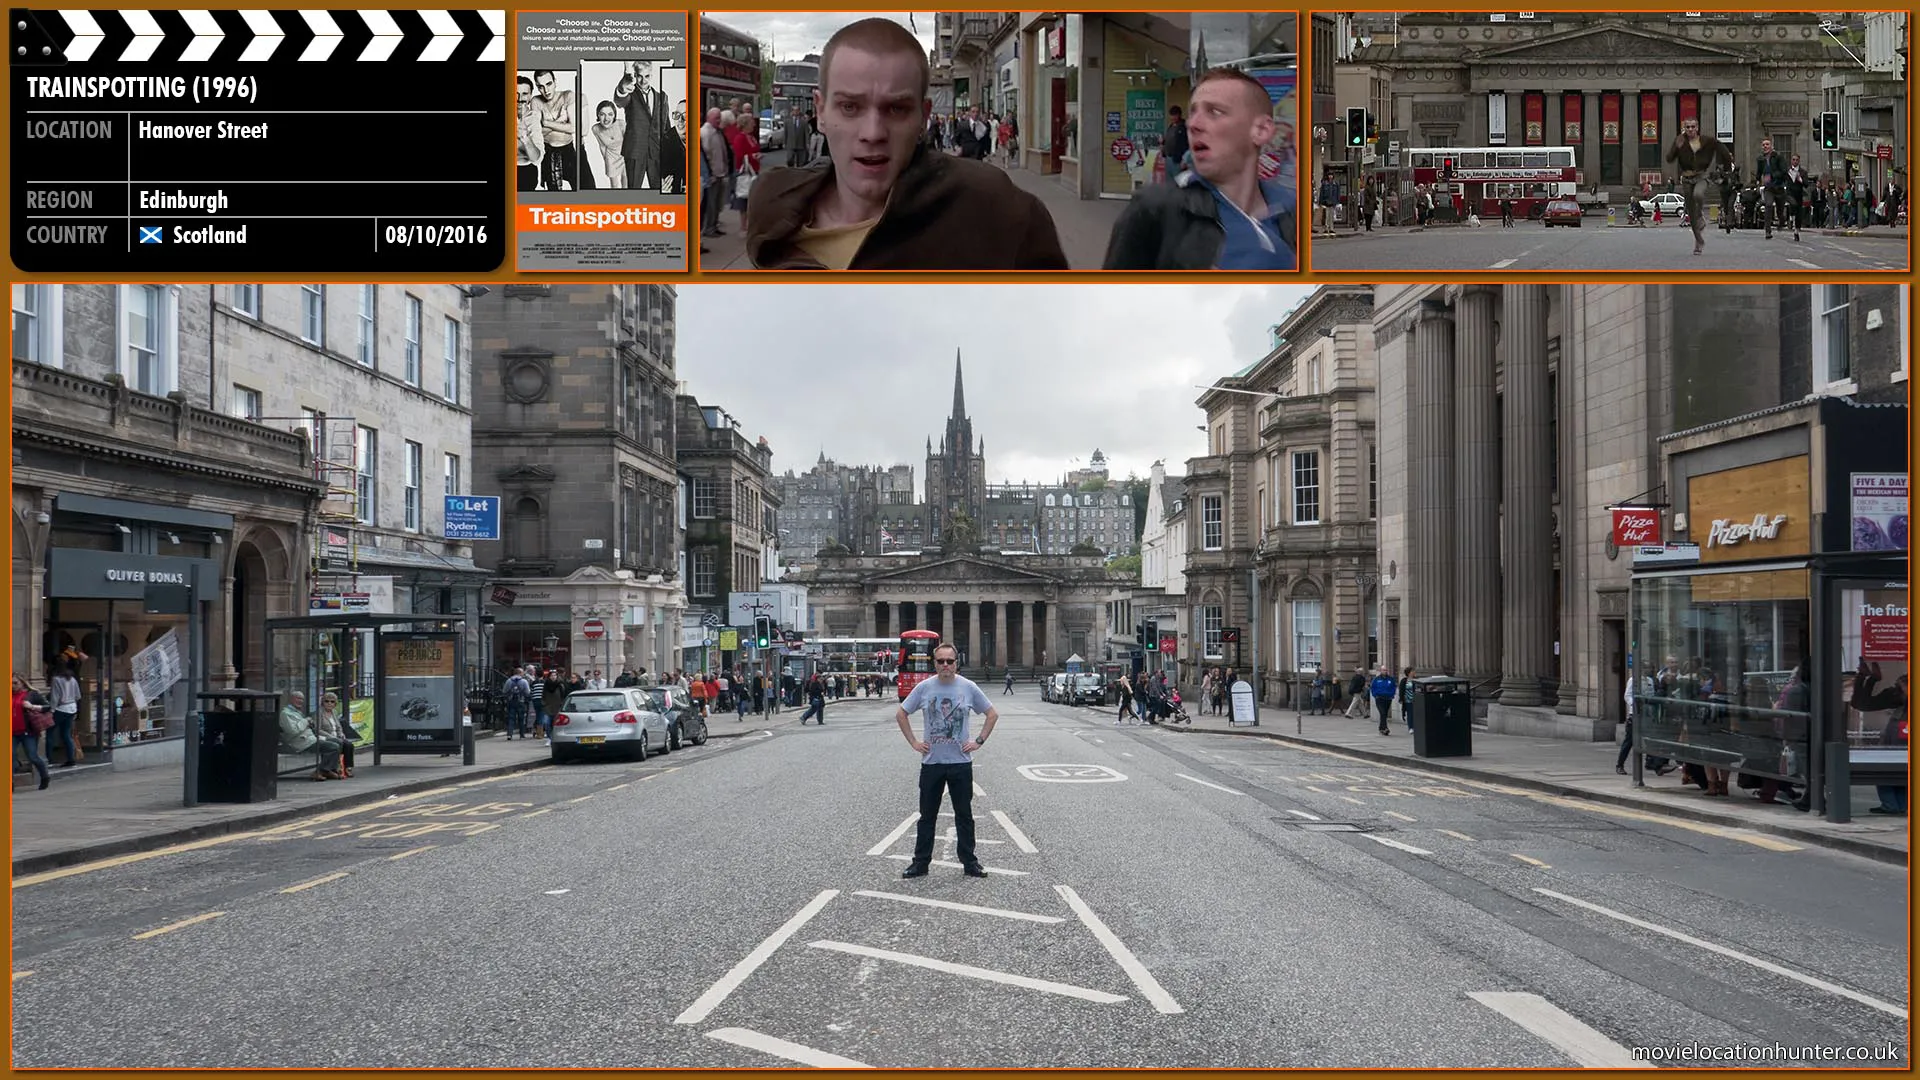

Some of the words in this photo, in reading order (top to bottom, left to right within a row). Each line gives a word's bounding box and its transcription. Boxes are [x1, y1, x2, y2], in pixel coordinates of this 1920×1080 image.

[1136, 99, 1156, 108] BEST
[1128, 110, 1164, 119] SELLERS
[1136, 121, 1156, 130] BEST
[528, 208, 676, 228] Trainspotting
[446, 522, 477, 531] Ryden
[1618, 516, 1654, 528] Pizza
[1624, 529, 1650, 540] Hut
[1707, 518, 1750, 548] Pizza
[1748, 513, 1786, 541] Hut
[107, 569, 144, 581] OLIVER
[149, 572, 183, 583] BONAS
[1859, 604, 1883, 616] The
[376, 802, 533, 818] BUS
[258, 822, 491, 841] STOP
